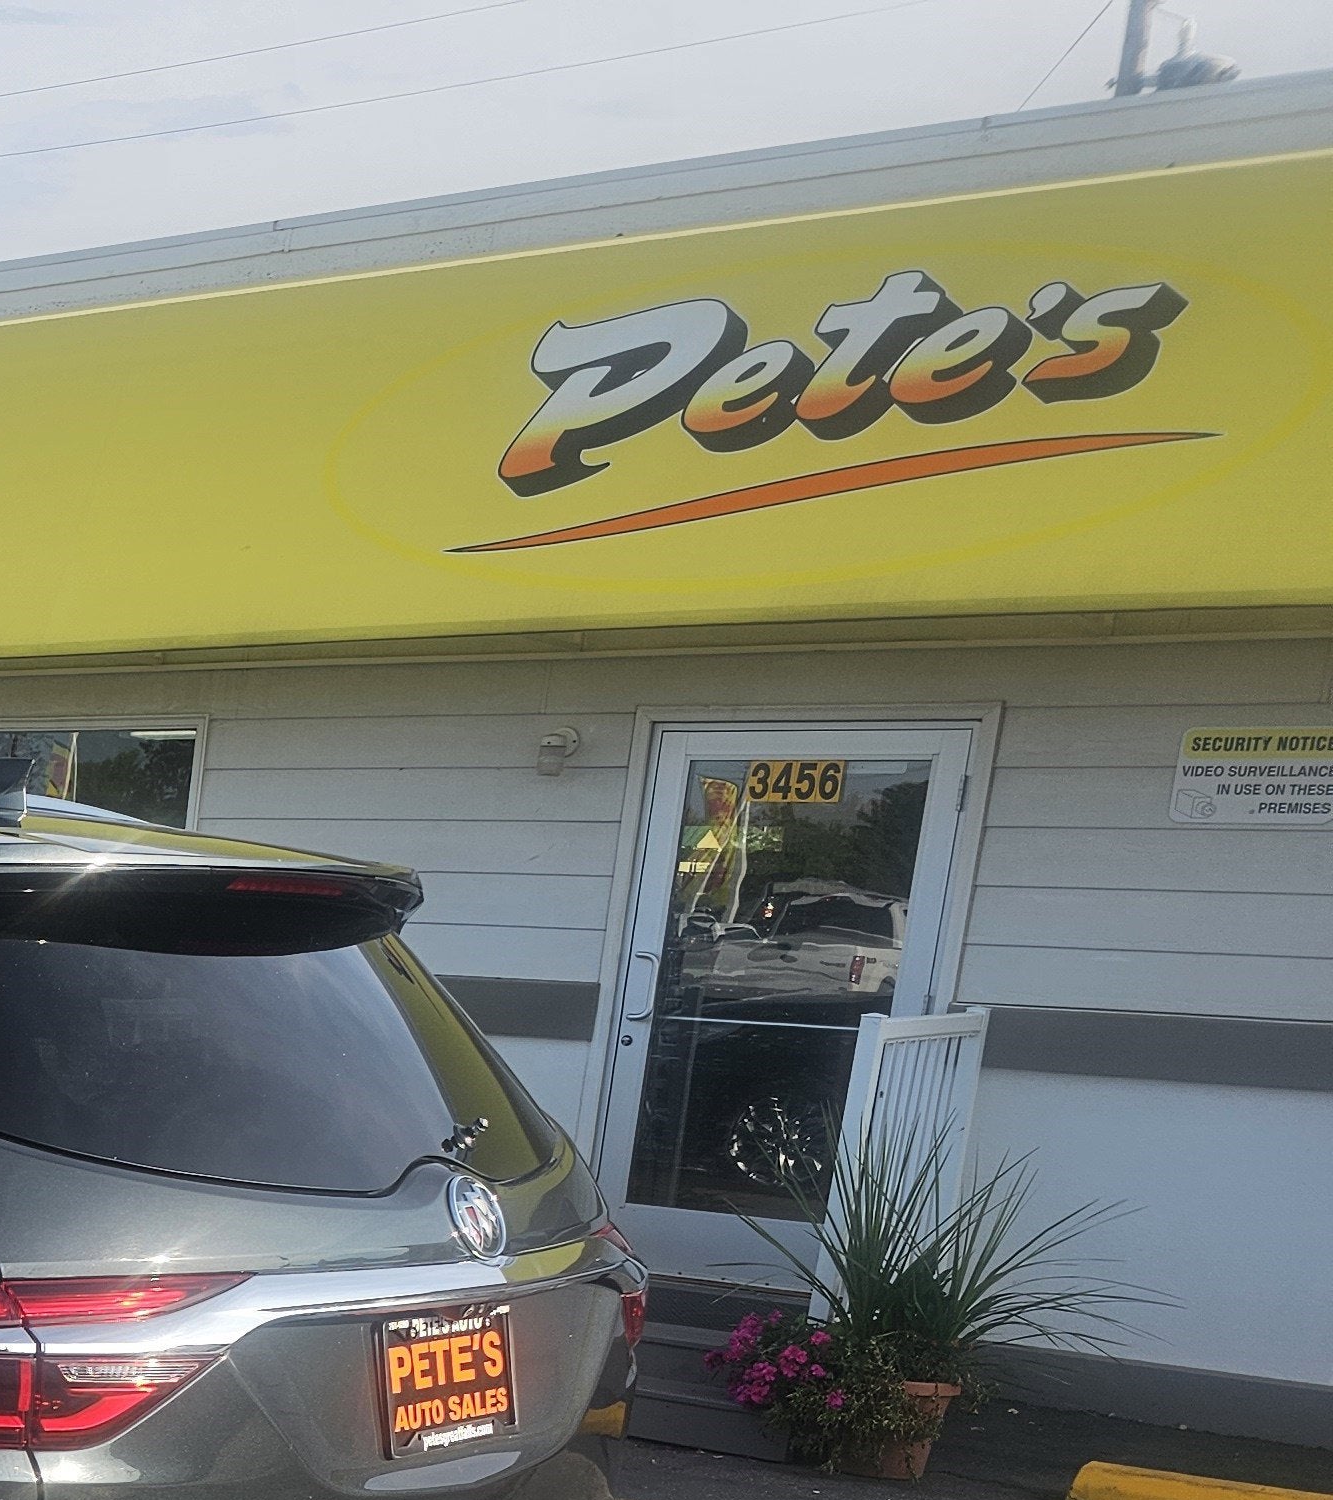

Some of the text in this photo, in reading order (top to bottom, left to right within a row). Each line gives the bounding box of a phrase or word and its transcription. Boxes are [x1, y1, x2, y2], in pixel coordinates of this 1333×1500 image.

[497, 269, 1189, 498] Pete's
[1191, 735, 1333, 752] SECURITY NOTICE
[748, 761, 842, 801] 3456
[1182, 765, 1225, 777] VIDEO
[1216, 784, 1333, 795] IN USE ON THESE
[1258, 802, 1332, 814] PREMISES
[388, 1330, 504, 1394] PETE'S
[394, 1387, 508, 1432] AUTO SALES
